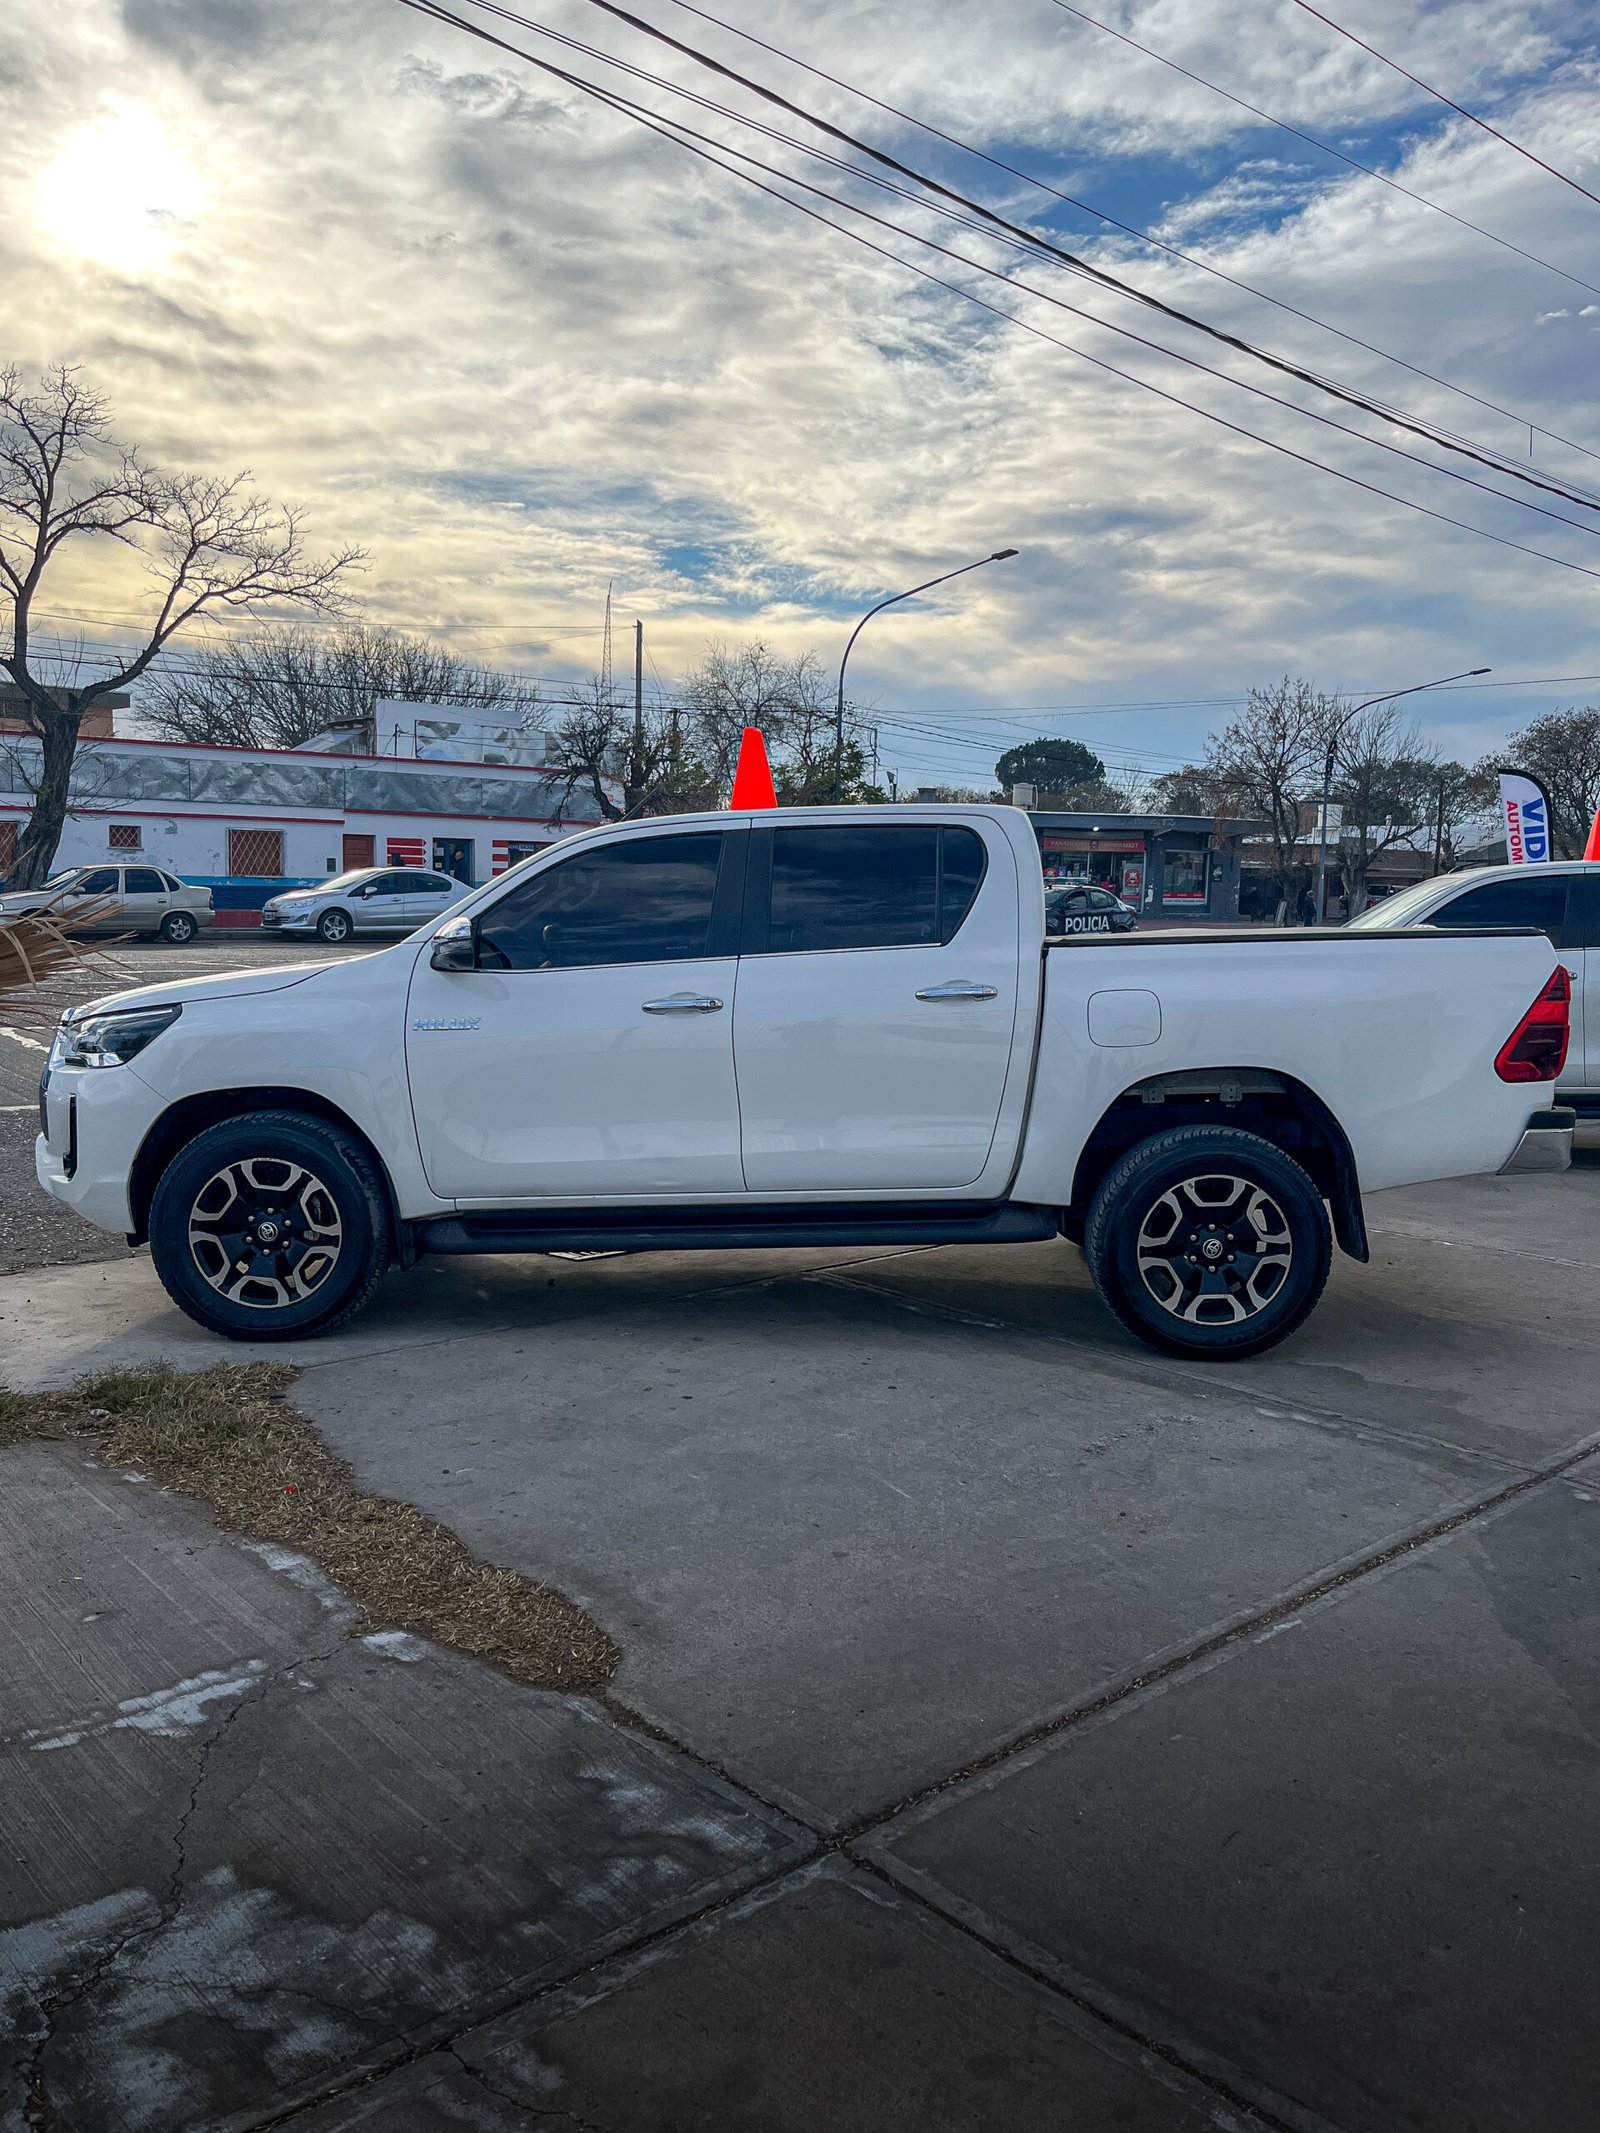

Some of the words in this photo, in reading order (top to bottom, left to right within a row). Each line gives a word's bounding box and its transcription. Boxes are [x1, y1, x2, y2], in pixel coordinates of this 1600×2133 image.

[1522, 797, 1547, 864] VID
[1065, 916, 1109, 932] POLICIA
[413, 1018, 481, 1031] HILUX
